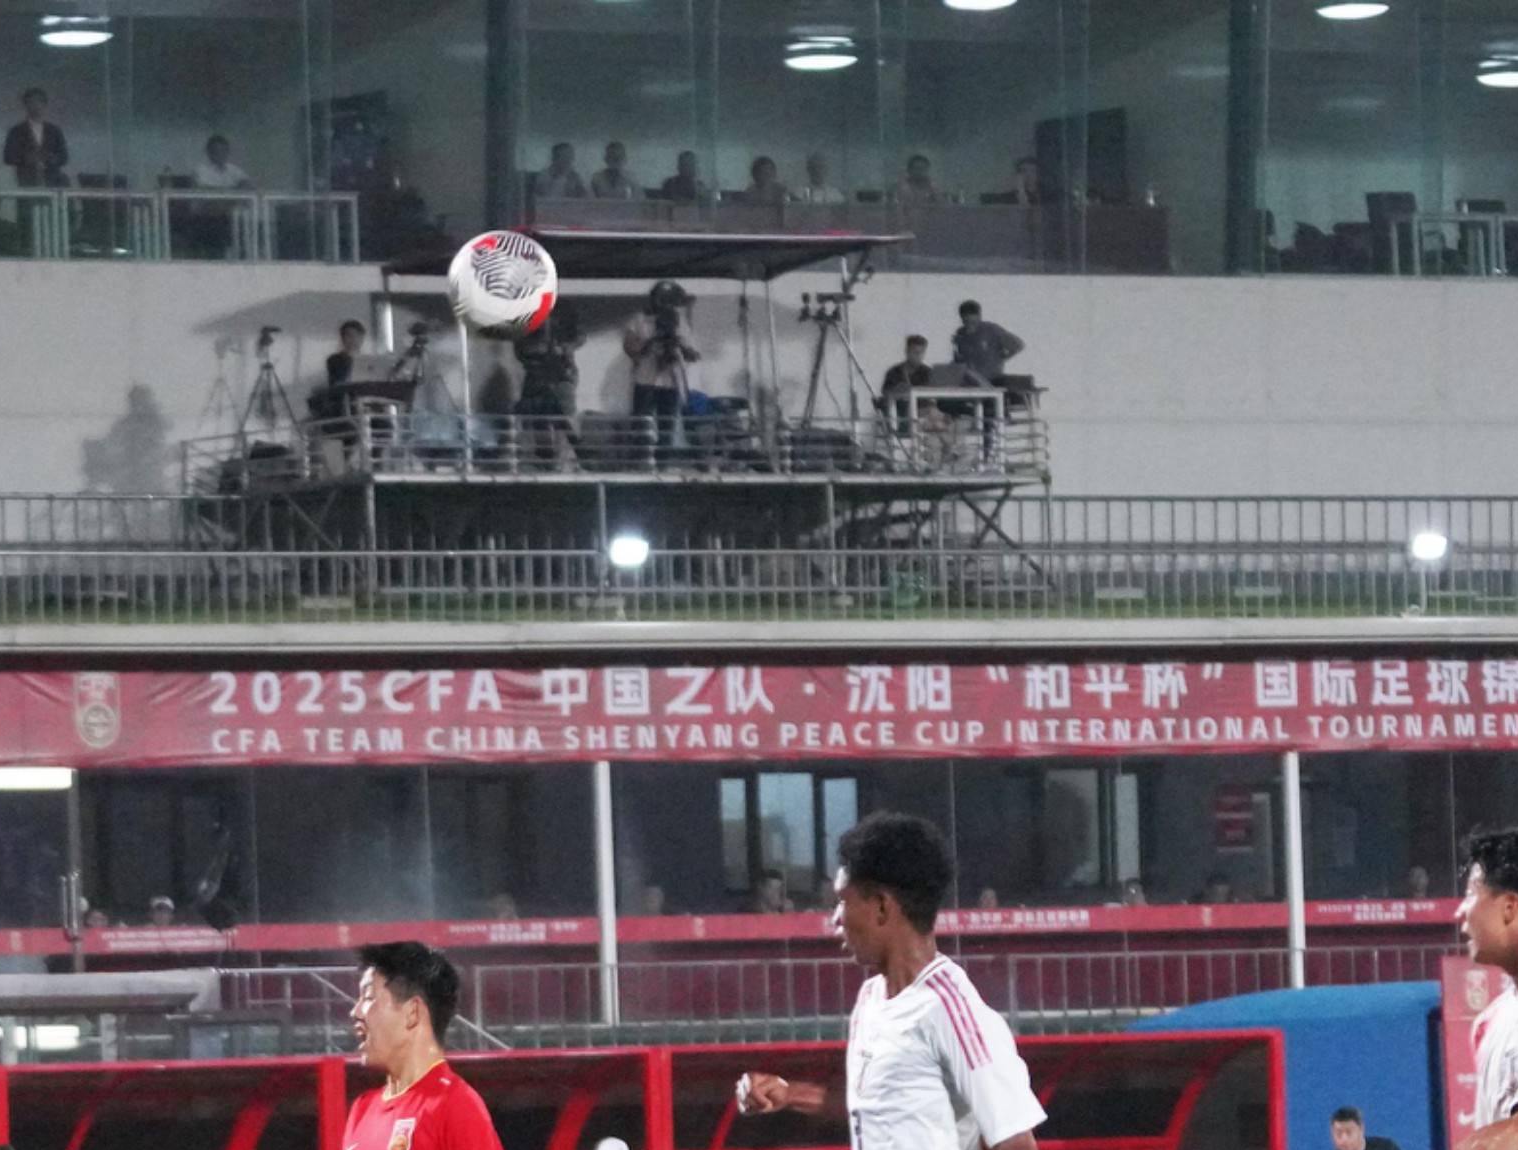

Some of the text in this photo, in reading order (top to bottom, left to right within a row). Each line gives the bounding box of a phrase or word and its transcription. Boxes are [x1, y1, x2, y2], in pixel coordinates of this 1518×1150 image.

[209, 669, 503, 714] 2025CFA
[211, 728, 281, 753] CFA
[303, 727, 403, 751] TEAM
[426, 726, 543, 750] CHINA
[563, 723, 760, 749] SHENYANG
[781, 721, 896, 747] PEACE
[915, 719, 984, 745] CUP
[1003, 714, 1289, 743] INTERNATIONAL
